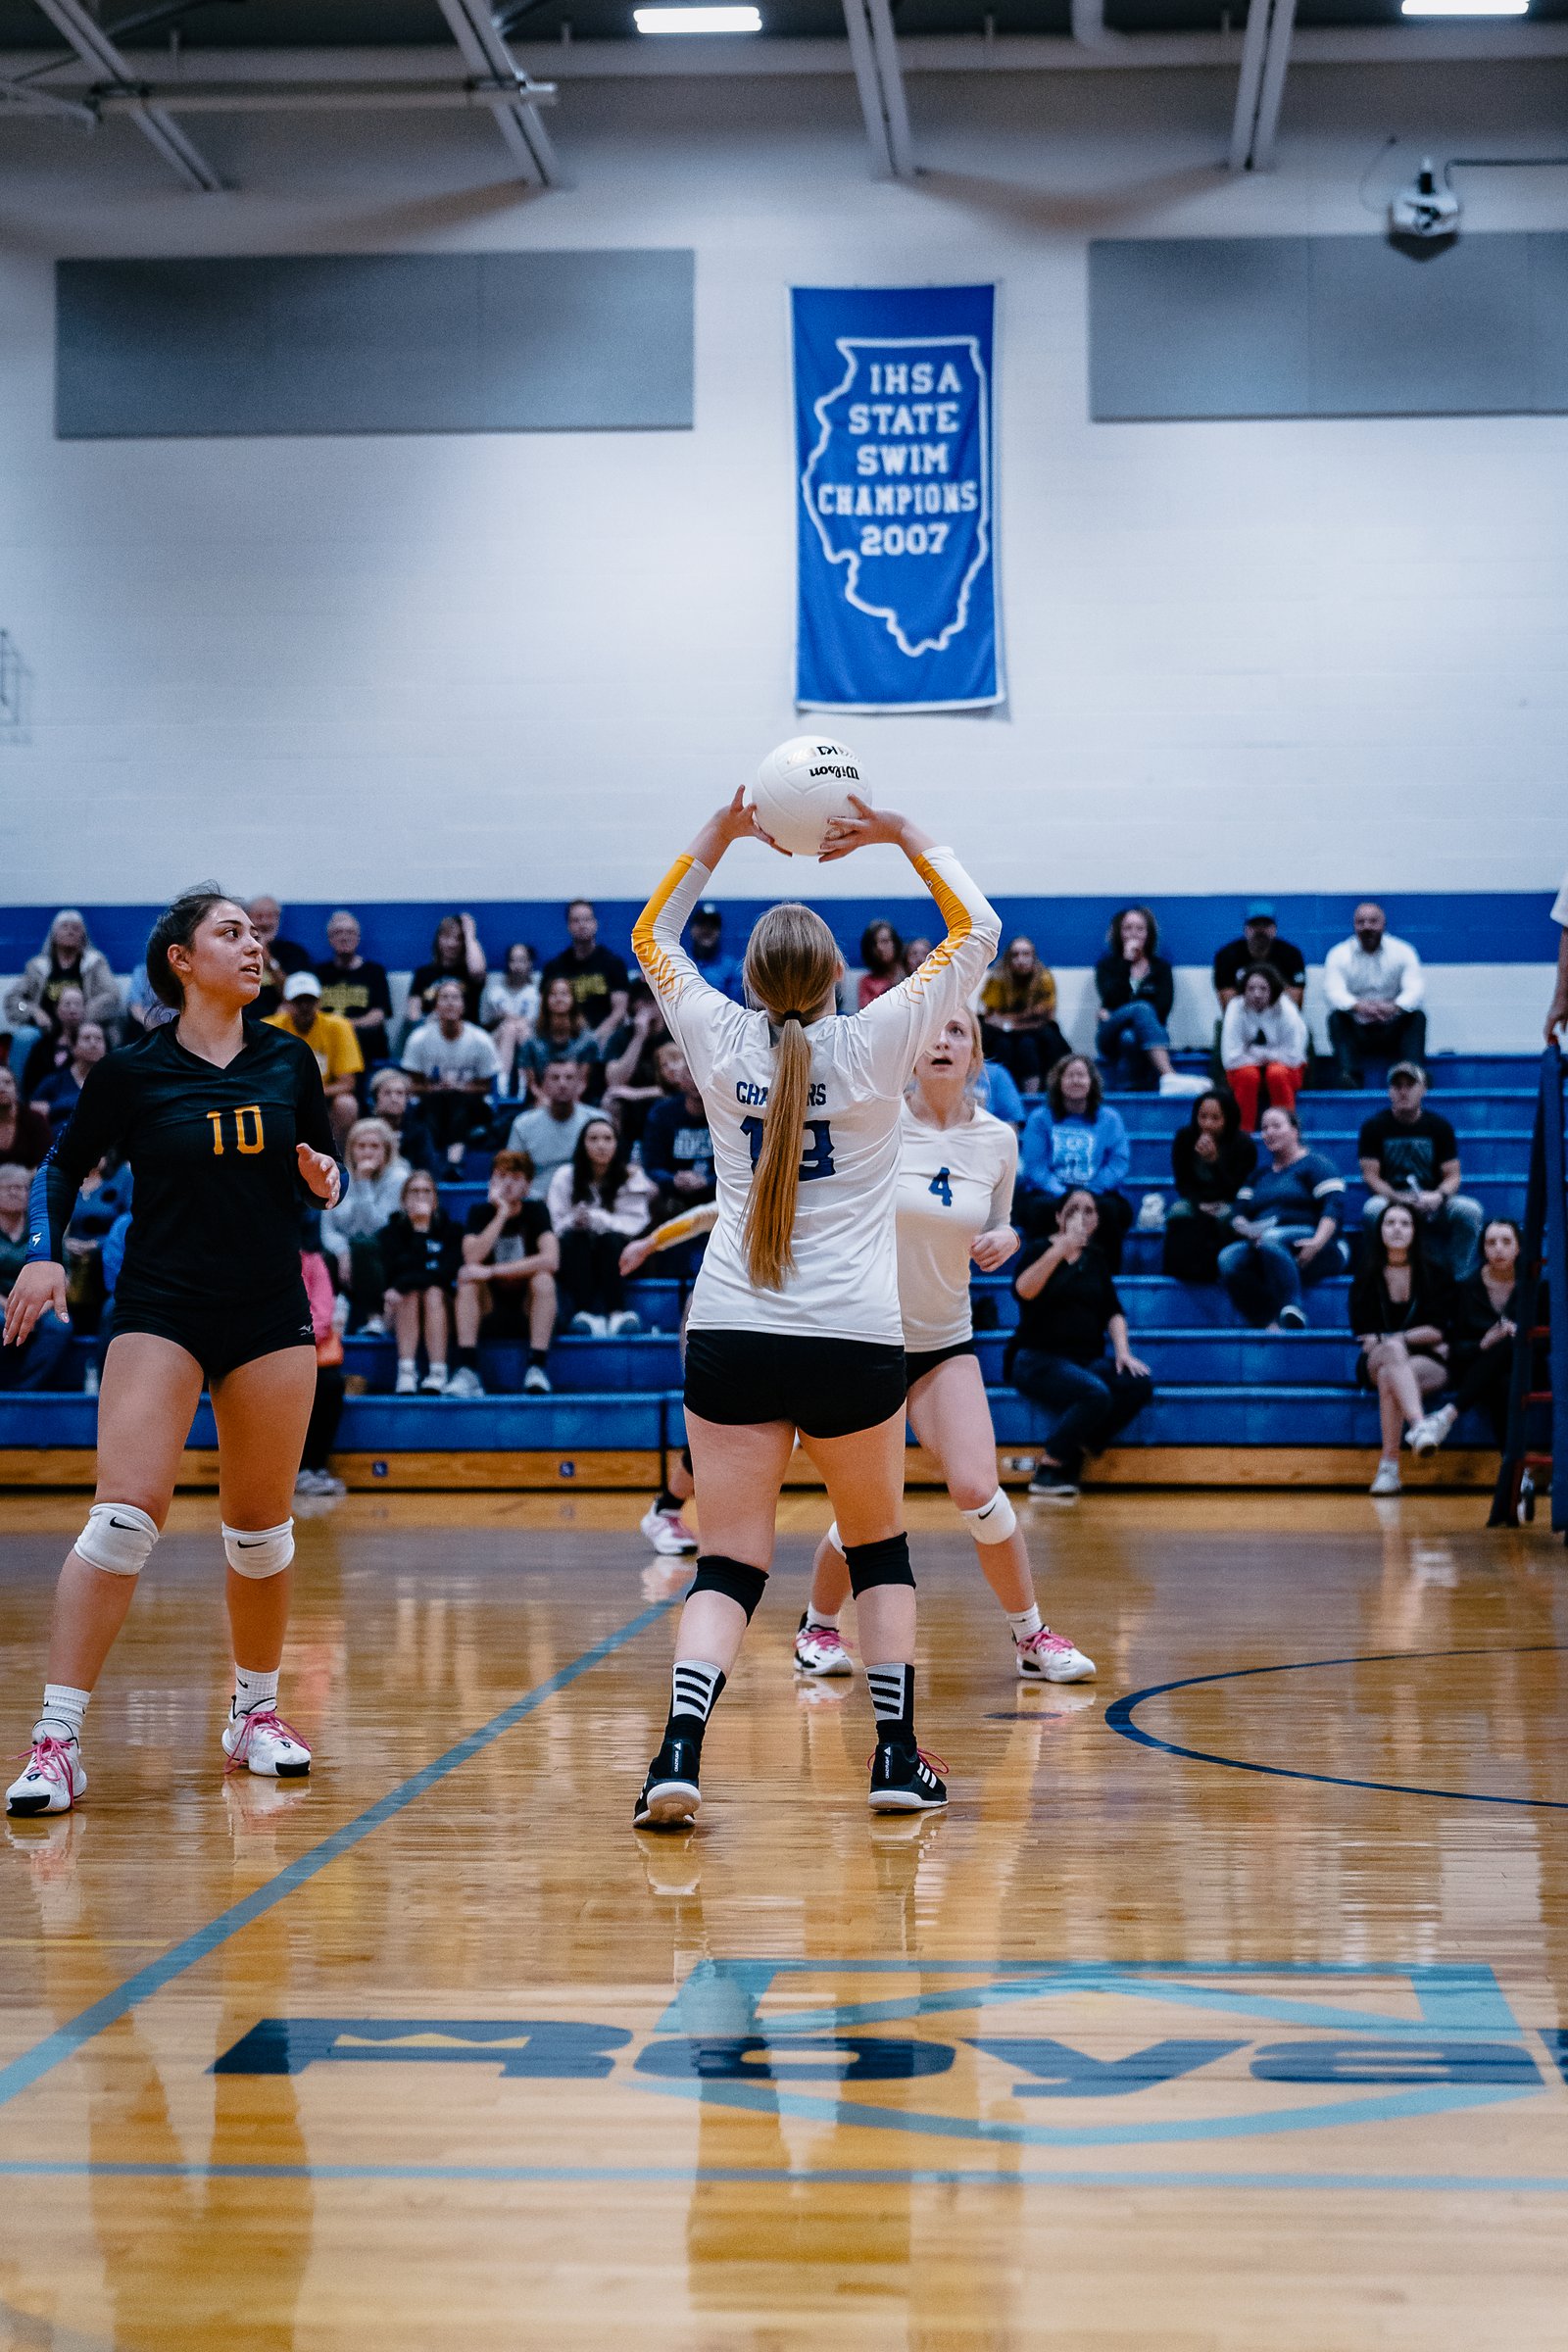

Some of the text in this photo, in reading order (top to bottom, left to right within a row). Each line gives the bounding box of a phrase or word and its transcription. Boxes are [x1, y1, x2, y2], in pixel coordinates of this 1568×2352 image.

[869, 363, 962, 394] IHSA
[848, 403, 959, 434] STATE
[856, 443, 949, 476] SWIM
[817, 481, 977, 515] CHAMPIONS
[860, 523, 950, 556] 2007
[808, 765, 860, 780] Wilson
[206, 1105, 265, 1154] 10
[928, 1166, 953, 1207] 4
[204, 2018, 1568, 2098] Roya
